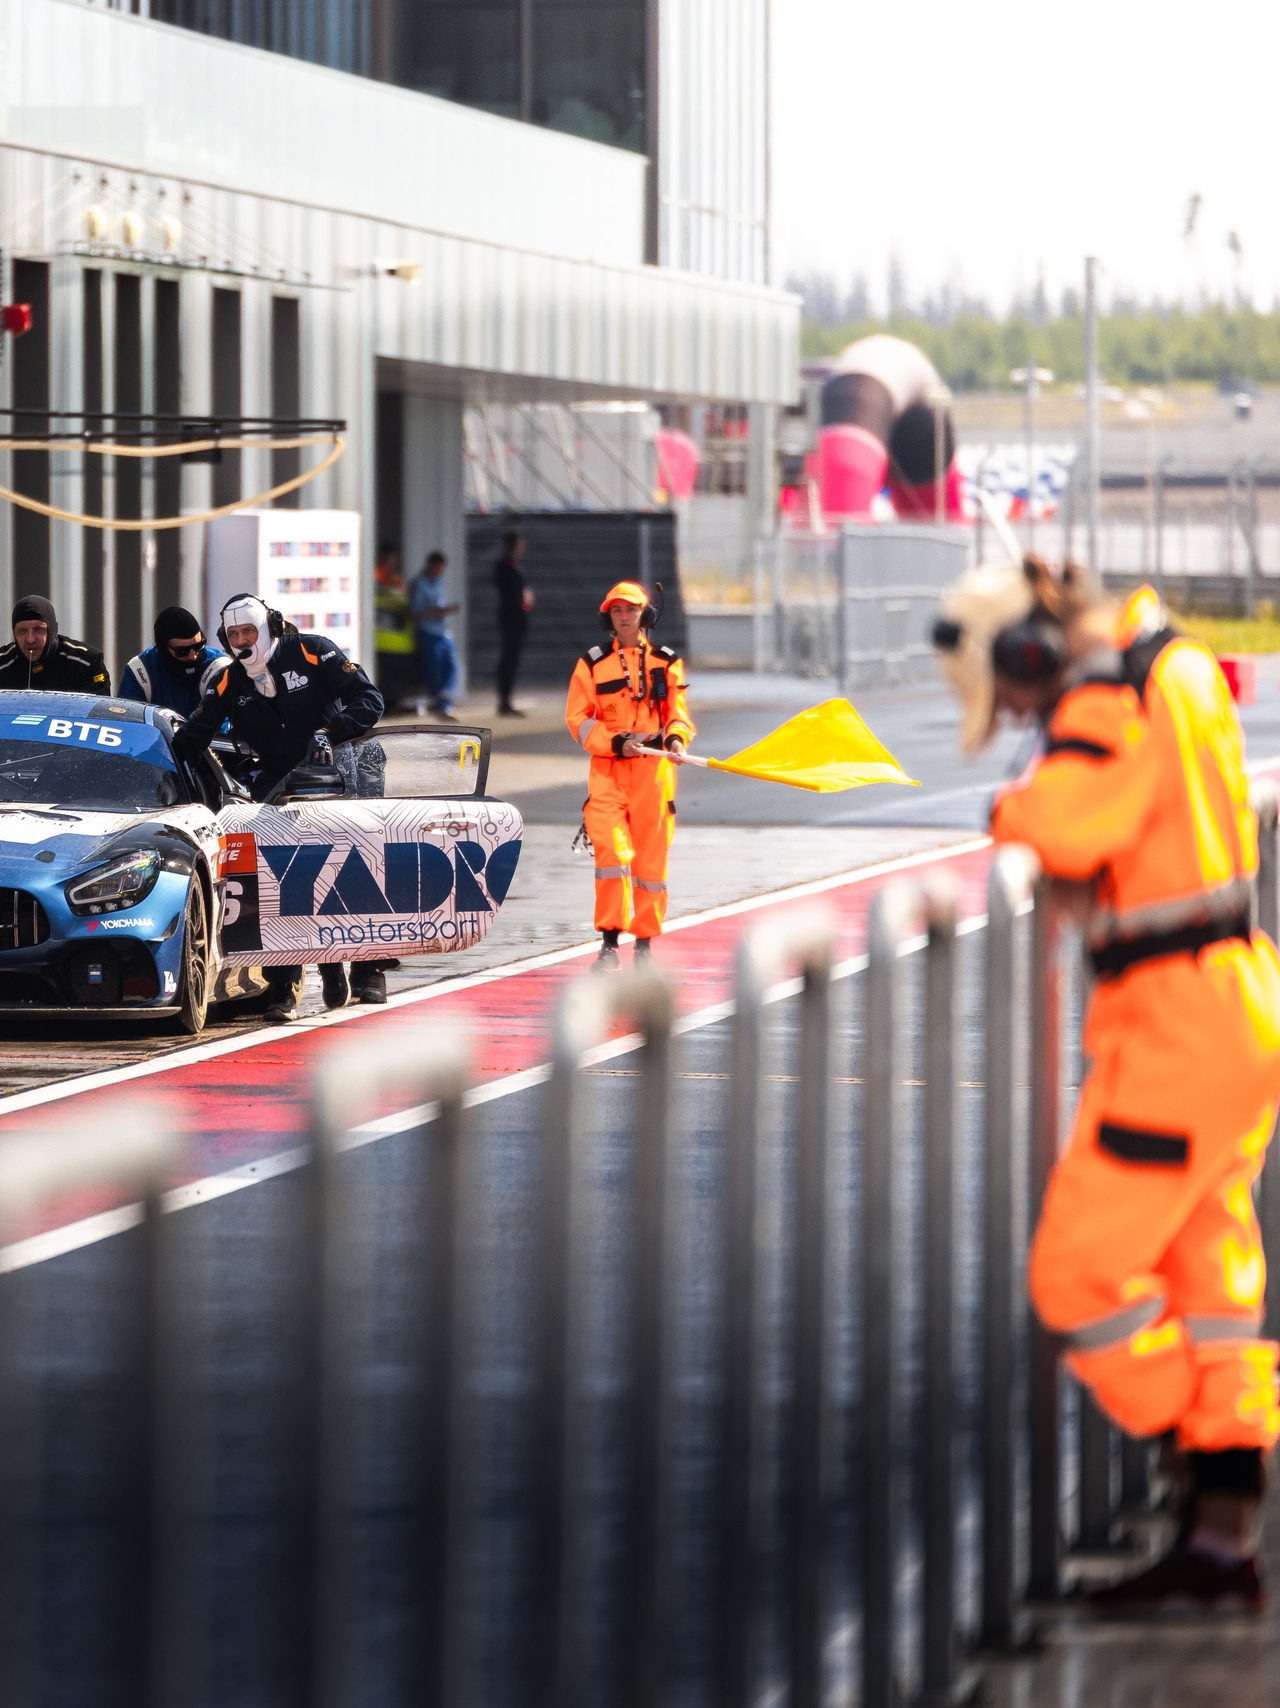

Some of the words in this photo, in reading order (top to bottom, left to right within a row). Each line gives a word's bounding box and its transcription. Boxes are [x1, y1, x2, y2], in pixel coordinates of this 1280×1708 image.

[47, 718, 122, 747] ВТБ
[100, 917, 155, 930] YOKOHAMA
[318, 914, 478, 947] motorsport
